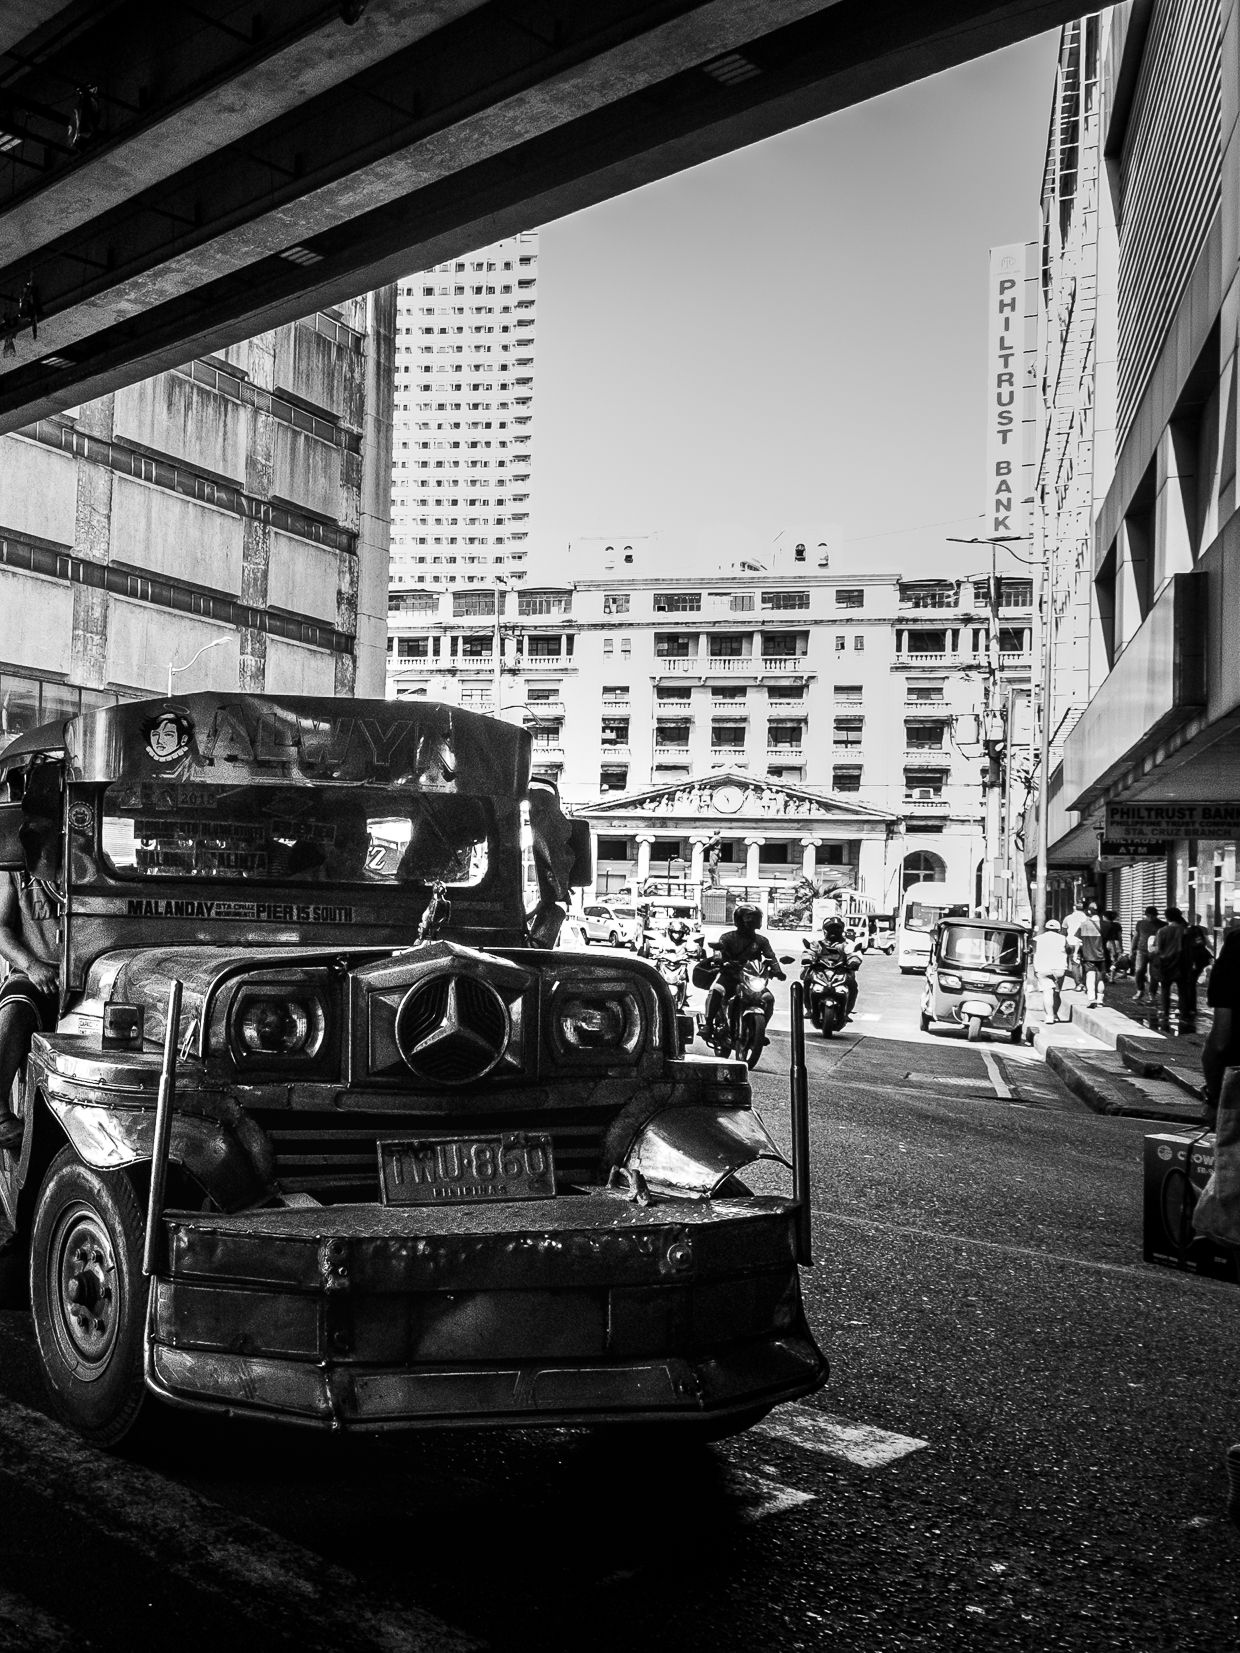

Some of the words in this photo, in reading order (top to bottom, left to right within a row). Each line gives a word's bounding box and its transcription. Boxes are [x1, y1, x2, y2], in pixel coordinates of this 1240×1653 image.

[996, 278, 1016, 445] PHILTRUST
[993, 460, 1013, 532] BANK
[1110, 807, 1197, 819] PHILTRUST
[1151, 828, 1181, 836] CRUZ
[1184, 828, 1232, 837] BRANCH
[1118, 846, 1149, 854] ATM
[127, 900, 215, 917] MALANDAY
[256, 903, 295, 921] PIER
[295, 905, 310, 921] 15
[312, 906, 354, 923] SOUTH
